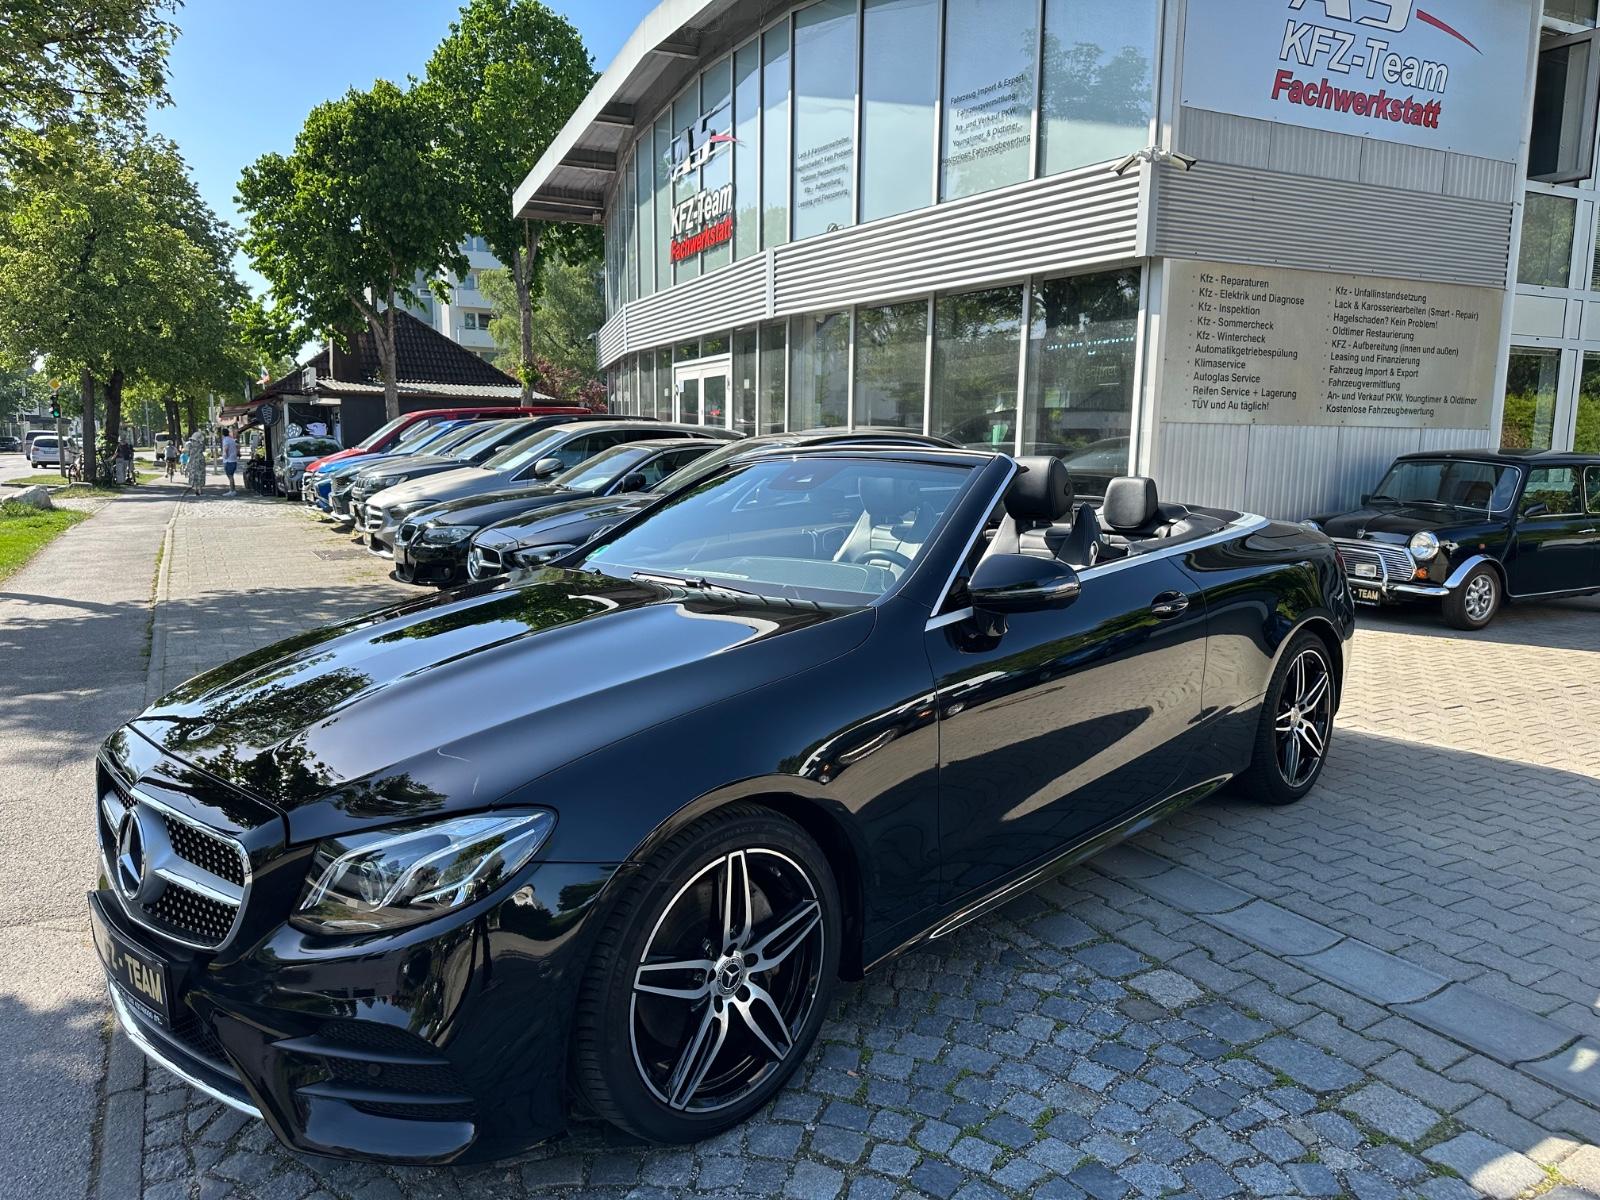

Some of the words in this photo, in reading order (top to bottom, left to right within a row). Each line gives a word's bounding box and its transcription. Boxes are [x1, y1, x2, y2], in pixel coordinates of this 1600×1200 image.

[1279, 19, 1448, 93] KFZ-Team
[951, 92, 976, 104] Fahrzeug
[977, 84, 996, 95] Import
[1004, 74, 1024, 86] Export
[1271, 69, 1441, 129] Fachwerkstatt
[671, 182, 733, 238] KFZ-Team
[670, 215, 733, 264] Fachwerkstatt
[1200, 274, 1213, 283] Kfz
[1221, 275, 1269, 288] Reparaturen
[1199, 288, 1213, 297] Kfz
[1220, 290, 1250, 301] Elektrik
[1269, 294, 1304, 305] Diagnose
[1336, 286, 1347, 296] Kfz
[1354, 288, 1426, 304] Unfallinstandsetzung
[1198, 303, 1211, 312] Kfz
[1219, 304, 1260, 315] Inspektion
[1334, 300, 1351, 310] Lack
[1354, 302, 1358, 310] &
[1361, 302, 1426, 315] Karosseriearbeiten
[1428, 308, 1450, 318] (Smart
[1455, 310, 1479, 321] Repair)
[1198, 317, 1211, 326] Kfz
[1218, 318, 1274, 330] Sommercheck
[1333, 313, 1388, 325] Hagelschaden?
[1391, 317, 1405, 326] Kein
[1408, 319, 1437, 329] Problem!
[1196, 331, 1209, 340] Kfz
[1217, 332, 1265, 343] Wintercheck
[1333, 327, 1364, 336] Oldtimer
[1366, 329, 1414, 341] Restaurierung
[1195, 344, 1298, 360] Automatikgetriebespülung
[1332, 340, 1346, 348] KFZ
[1353, 341, 1398, 353] Aufbereitung
[1400, 345, 1420, 354] (innen
[1436, 347, 1458, 357] außen)
[1194, 358, 1246, 369] Klimaservice
[1330, 352, 1358, 363] Leasing
[1376, 355, 1420, 367] Finanzierung
[1193, 372, 1229, 382] Autoglas
[1232, 373, 1260, 383] Service
[1330, 365, 1362, 376] Fahrzeug
[1365, 367, 1387, 377] Import
[1397, 369, 1418, 379] Export
[1328, 378, 1400, 391] Fahrzeugvermittlung
[1193, 386, 1218, 396] Reifen
[1221, 387, 1250, 397] Service
[1261, 388, 1296, 400] Lagerung
[1327, 391, 1339, 400] An-
[1357, 393, 1384, 401] Verkauf
[1405, 394, 1442, 405] Youngtimer
[1444, 395, 1448, 403] &
[1450, 396, 1477, 404] Oldtimer
[1192, 398, 1208, 408] TÜV
[1211, 401, 1225, 409] und
[1228, 401, 1238, 410] Au
[1241, 401, 1269, 412] täglich!
[1326, 404, 1366, 414] Kostenlose
[1368, 405, 1434, 417] Fahrzeugbewertung
[1358, 589, 1378, 600] TEAM
[125, 953, 163, 1004] TEAM
